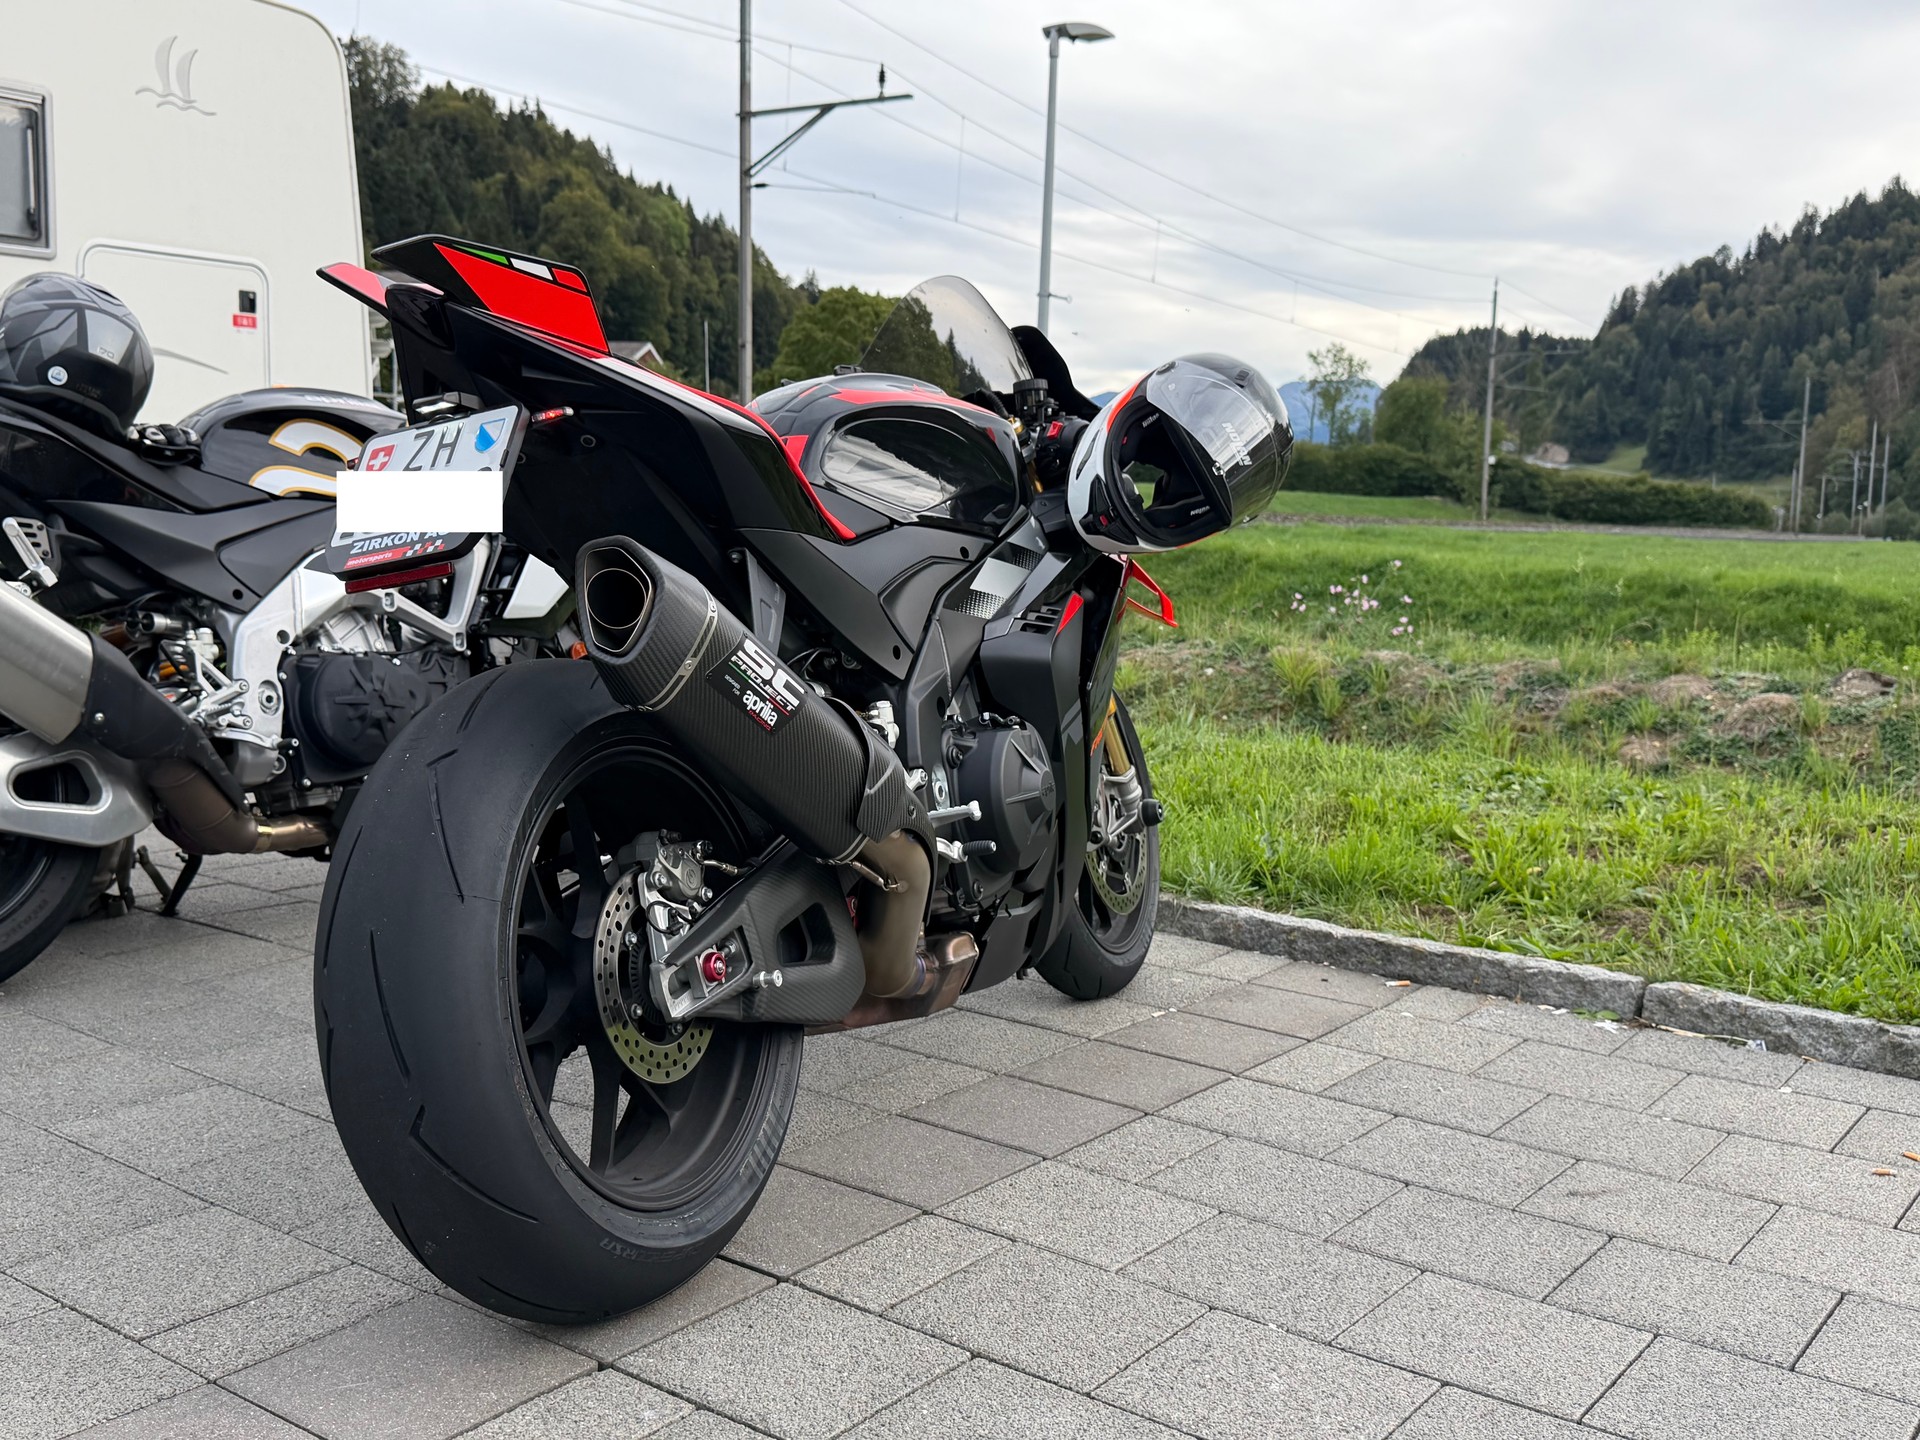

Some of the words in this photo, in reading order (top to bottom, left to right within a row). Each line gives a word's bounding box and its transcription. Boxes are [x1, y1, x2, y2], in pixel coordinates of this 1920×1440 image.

[402, 421, 465, 471] ZH
[1221, 422, 1253, 466] NOLAN
[346, 551, 393, 566] motorsports
[349, 531, 422, 555] ZIRKON
[730, 655, 796, 711] PROJECT
[737, 638, 805, 707] SC
[742, 690, 778, 727] aprilia
[748, 710, 772, 731] RACING
